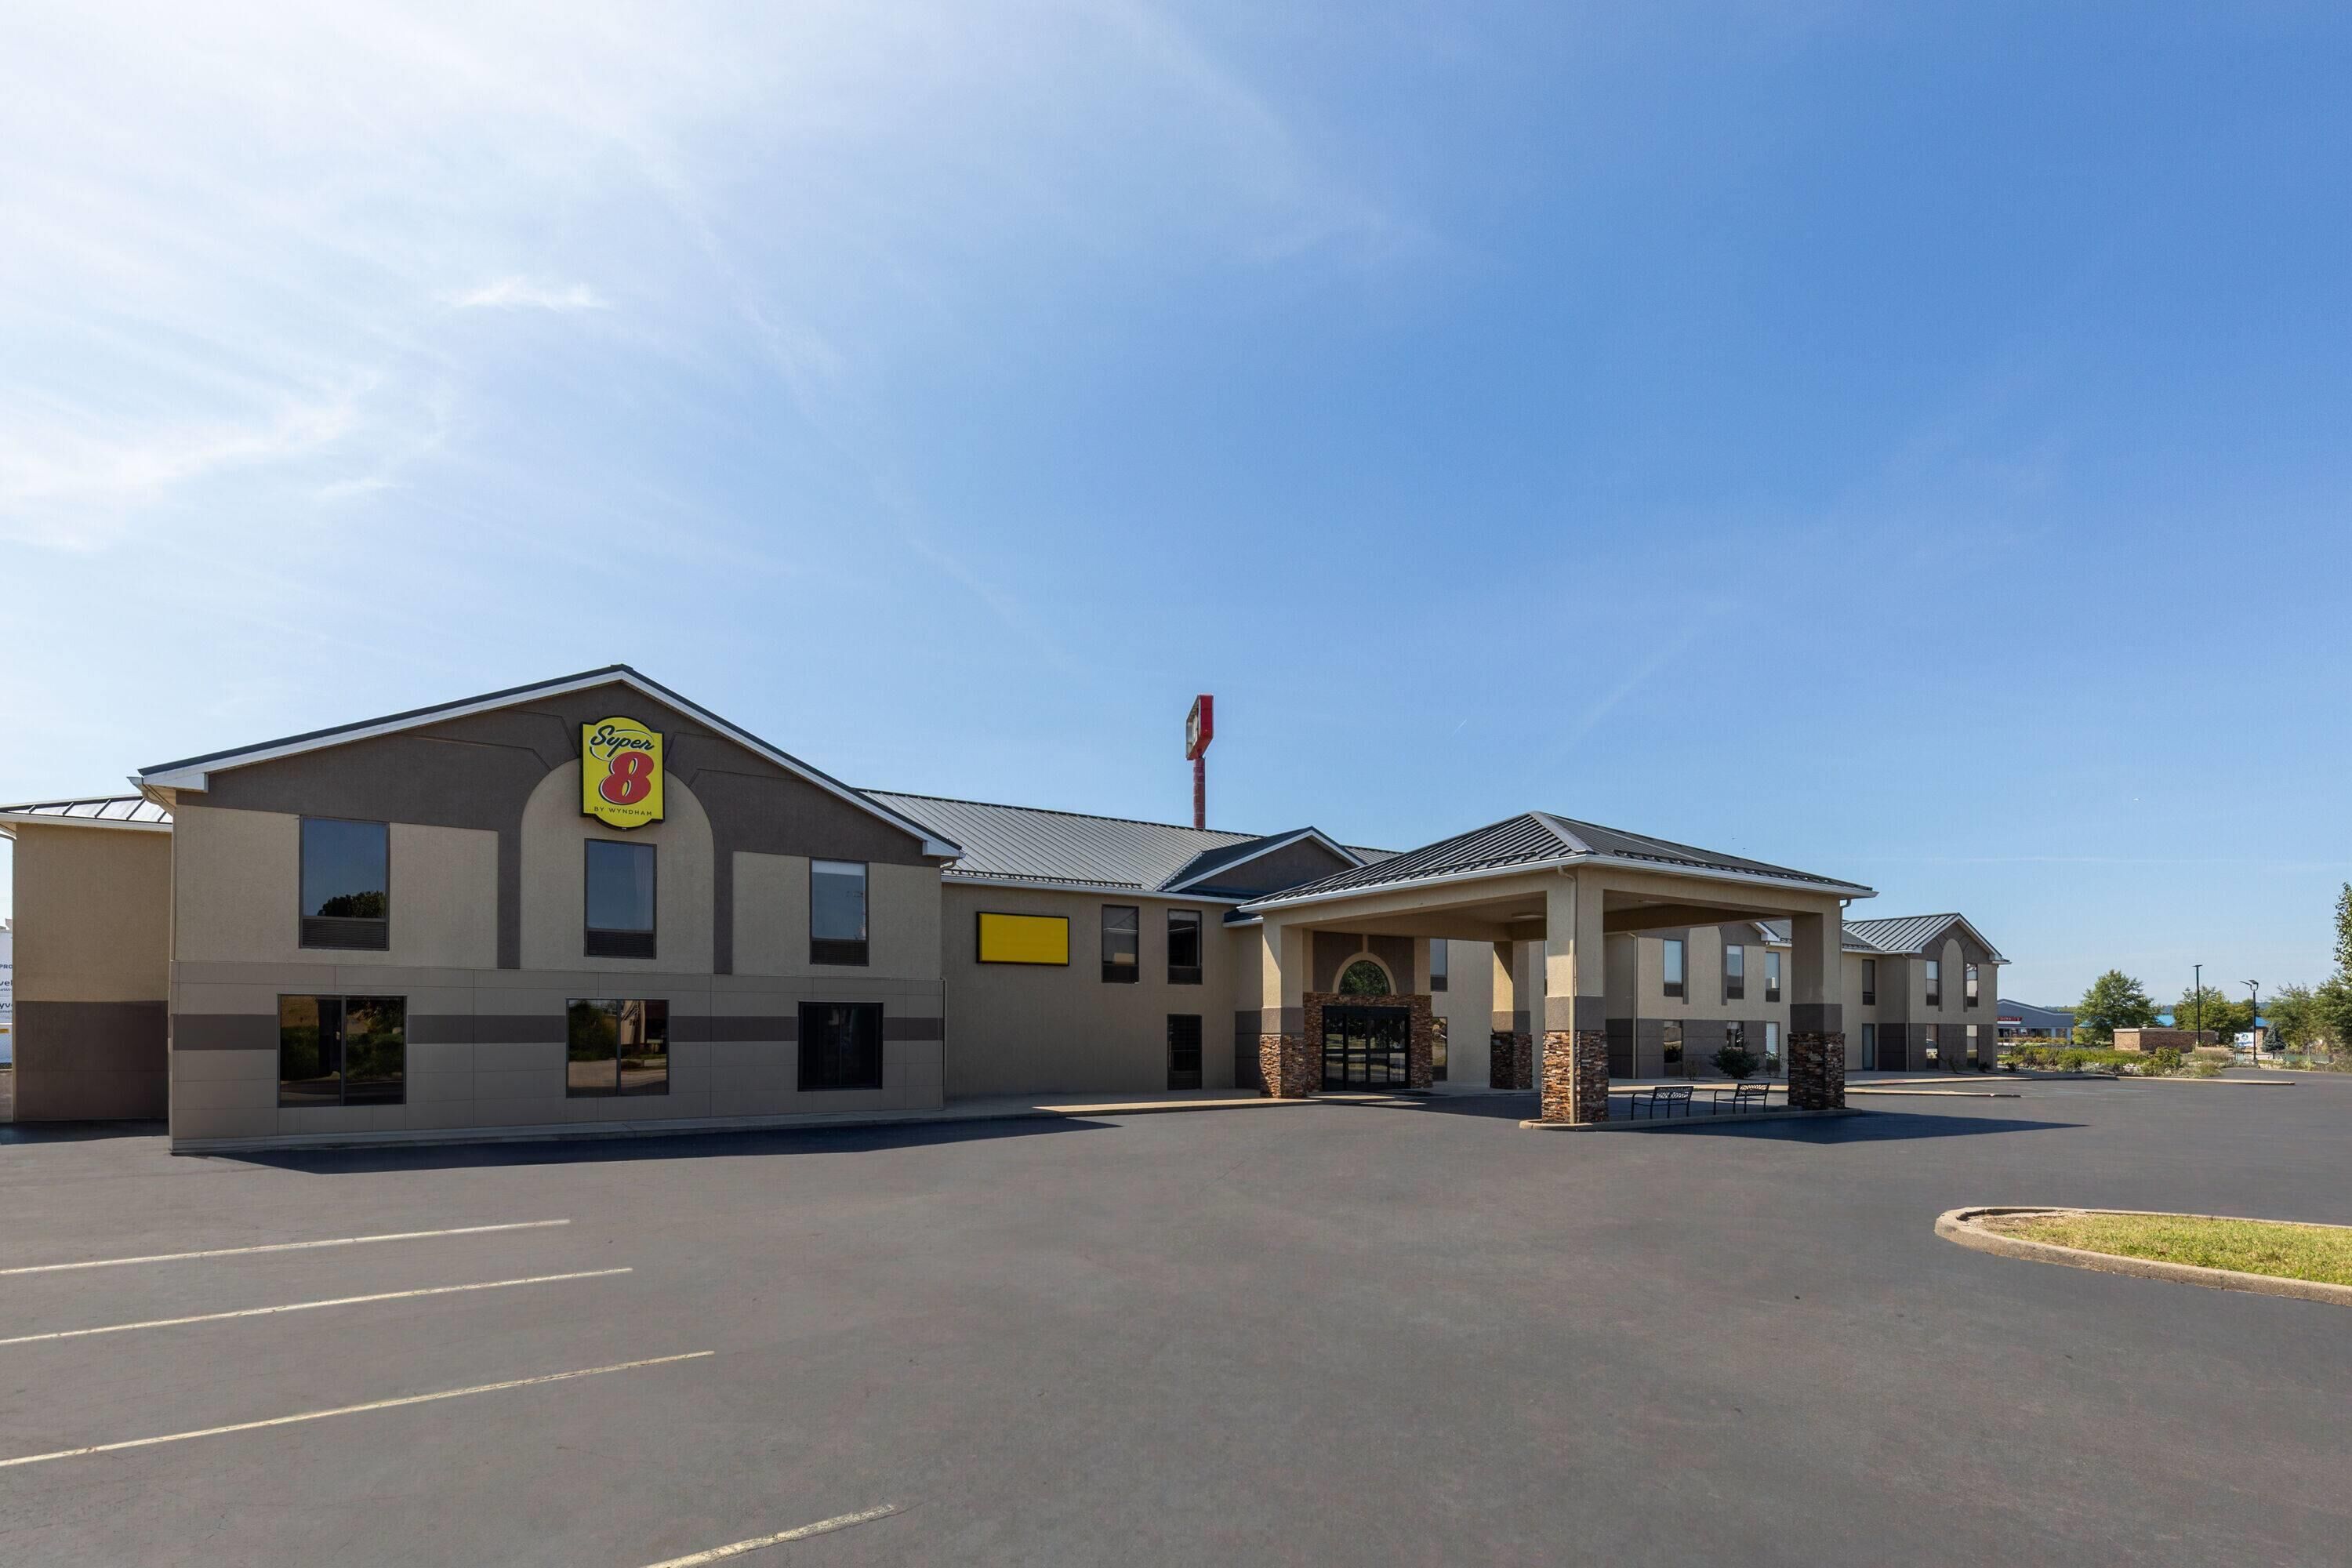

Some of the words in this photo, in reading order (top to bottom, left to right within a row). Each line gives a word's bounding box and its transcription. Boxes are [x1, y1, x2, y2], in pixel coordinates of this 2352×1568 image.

[590, 725, 655, 757] Super
[598, 751, 655, 805] 8
[608, 808, 652, 816] WYNDHAM
